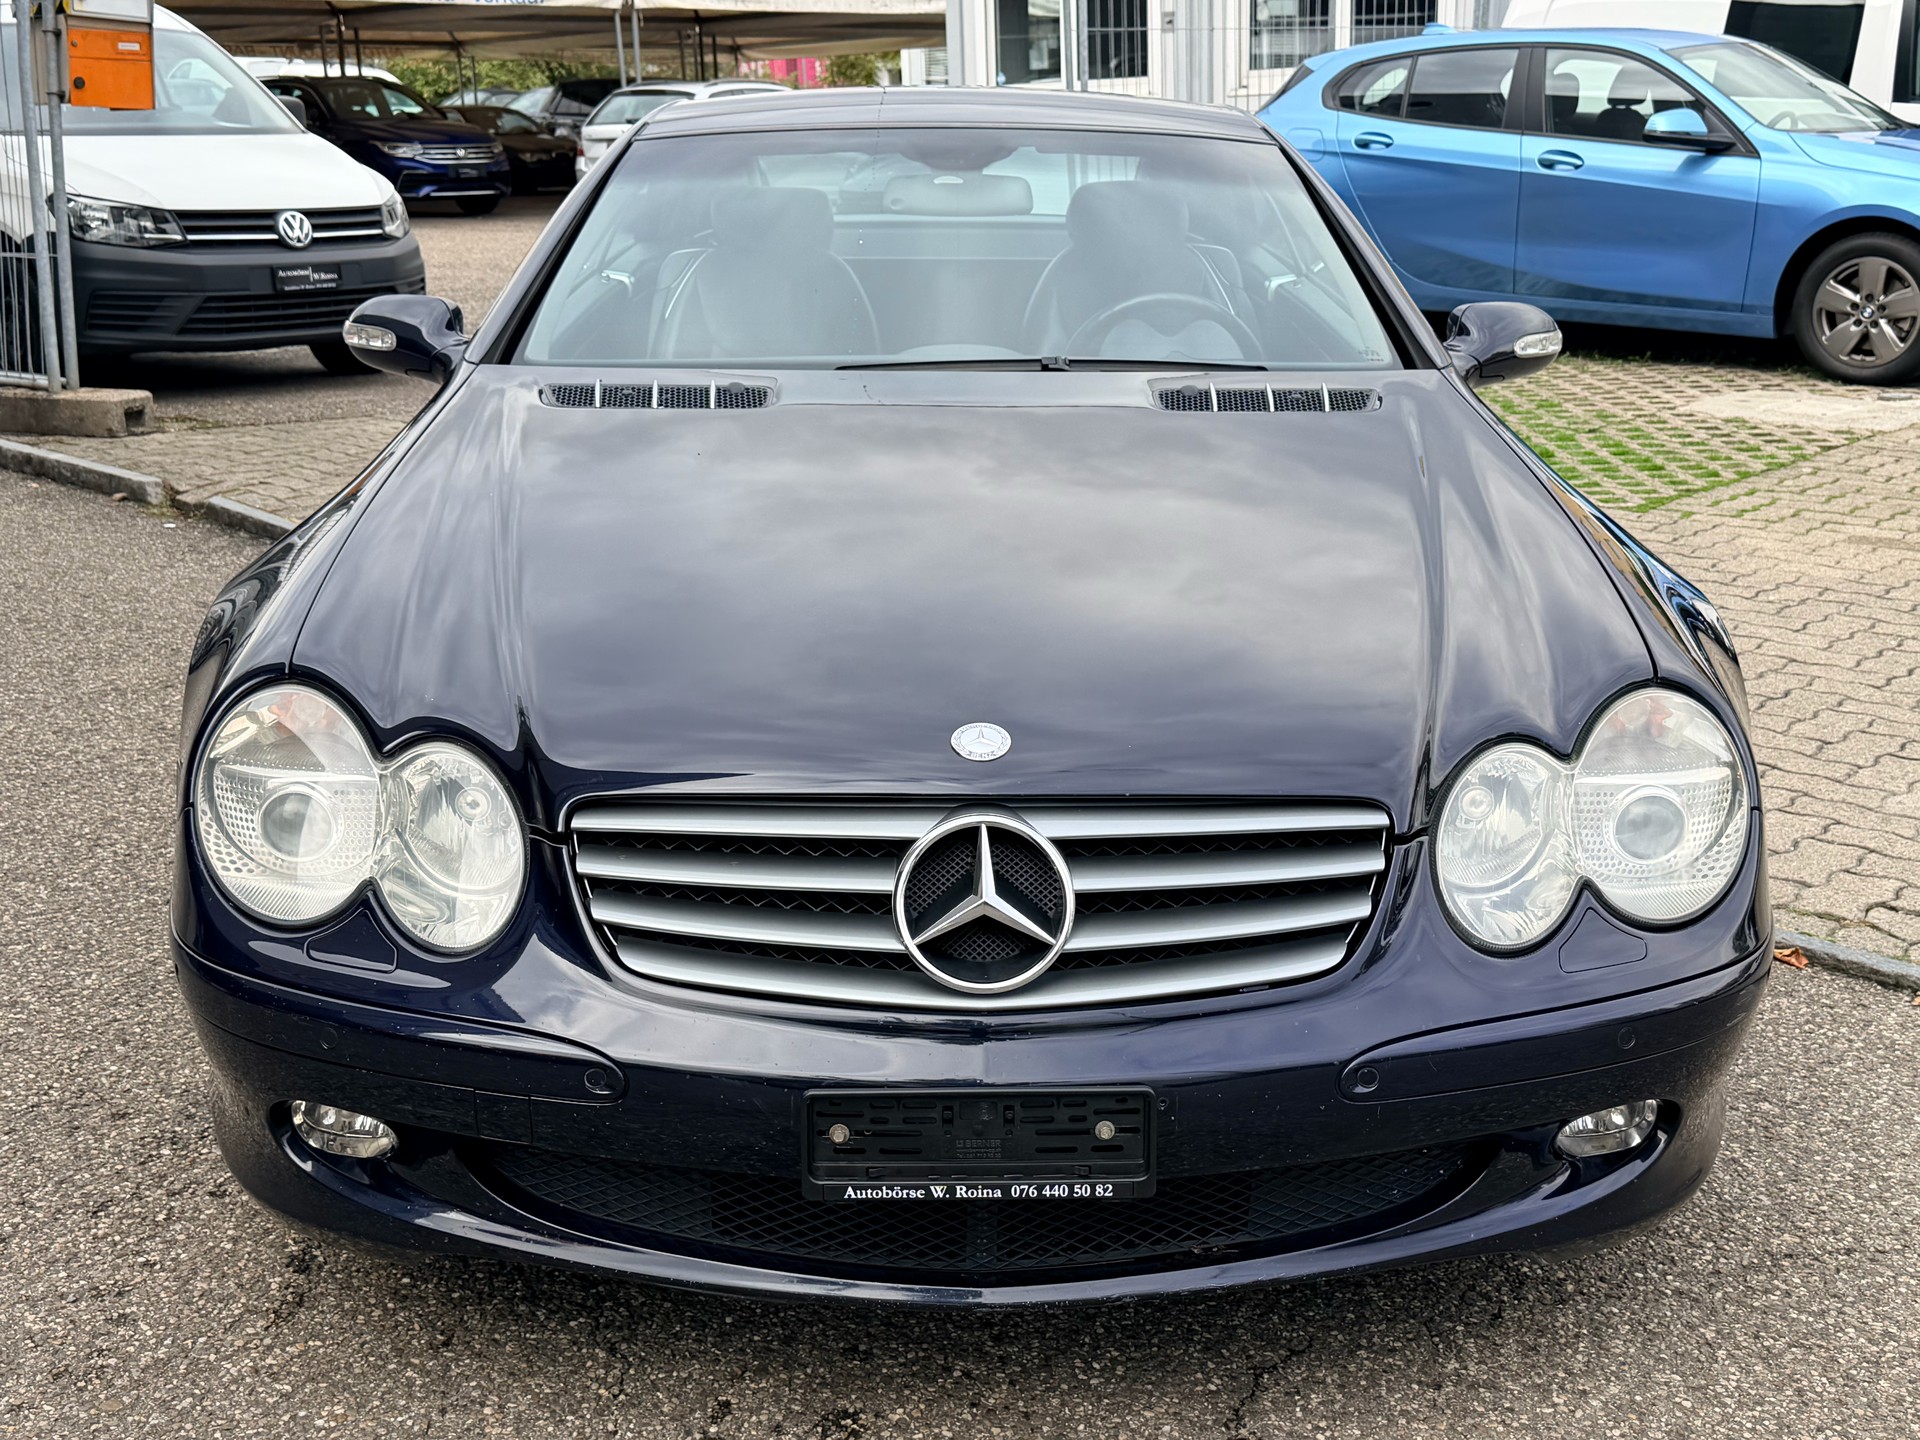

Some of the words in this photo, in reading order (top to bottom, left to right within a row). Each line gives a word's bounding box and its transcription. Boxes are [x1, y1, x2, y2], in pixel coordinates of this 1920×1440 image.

[844, 1186, 926, 1199] Autobörse
[929, 1185, 950, 1198] W.
[955, 1185, 1002, 1198] Roina
[1011, 1185, 1038, 1198] 076
[1042, 1184, 1068, 1197] 440
[1073, 1184, 1091, 1197] 50
[1095, 1184, 1113, 1197] 82
